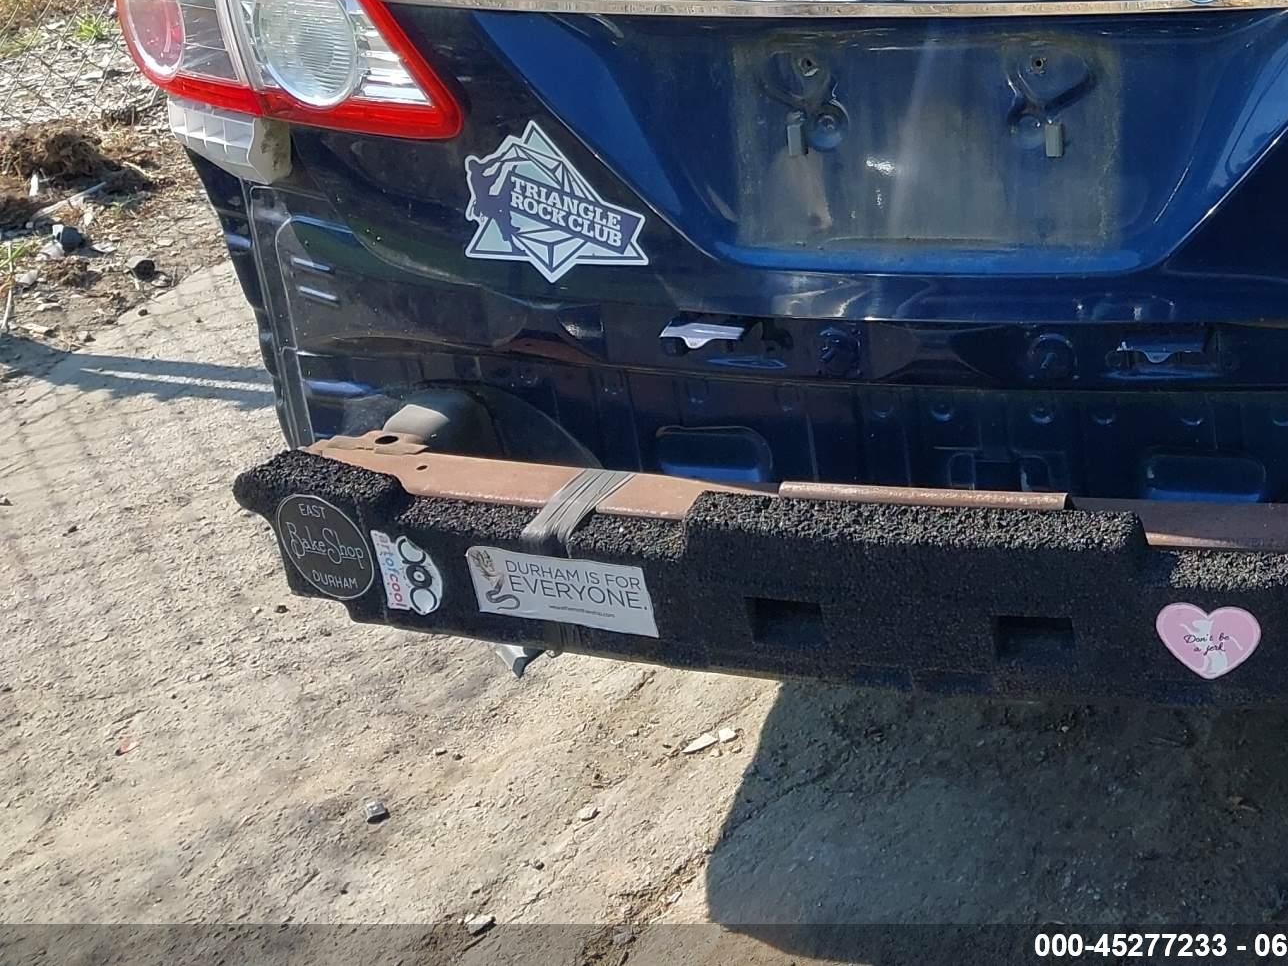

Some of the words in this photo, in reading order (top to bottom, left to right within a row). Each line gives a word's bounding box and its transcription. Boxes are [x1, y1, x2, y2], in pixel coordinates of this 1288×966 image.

[510, 175, 621, 231] TRIANGLE
[510, 191, 566, 227] ROCK
[567, 213, 622, 247] CLUB
[298, 503, 326, 520] EAST
[311, 569, 359, 589] DURHAM
[505, 559, 579, 583] DURHAM
[585, 570, 601, 585] IS
[604, 573, 642, 591] FOR
[508, 574, 648, 611] EVERYONE.
[1184, 633, 1213, 644] Don't
[1218, 632, 1230, 641] be
[1203, 641, 1226, 656] jerk
